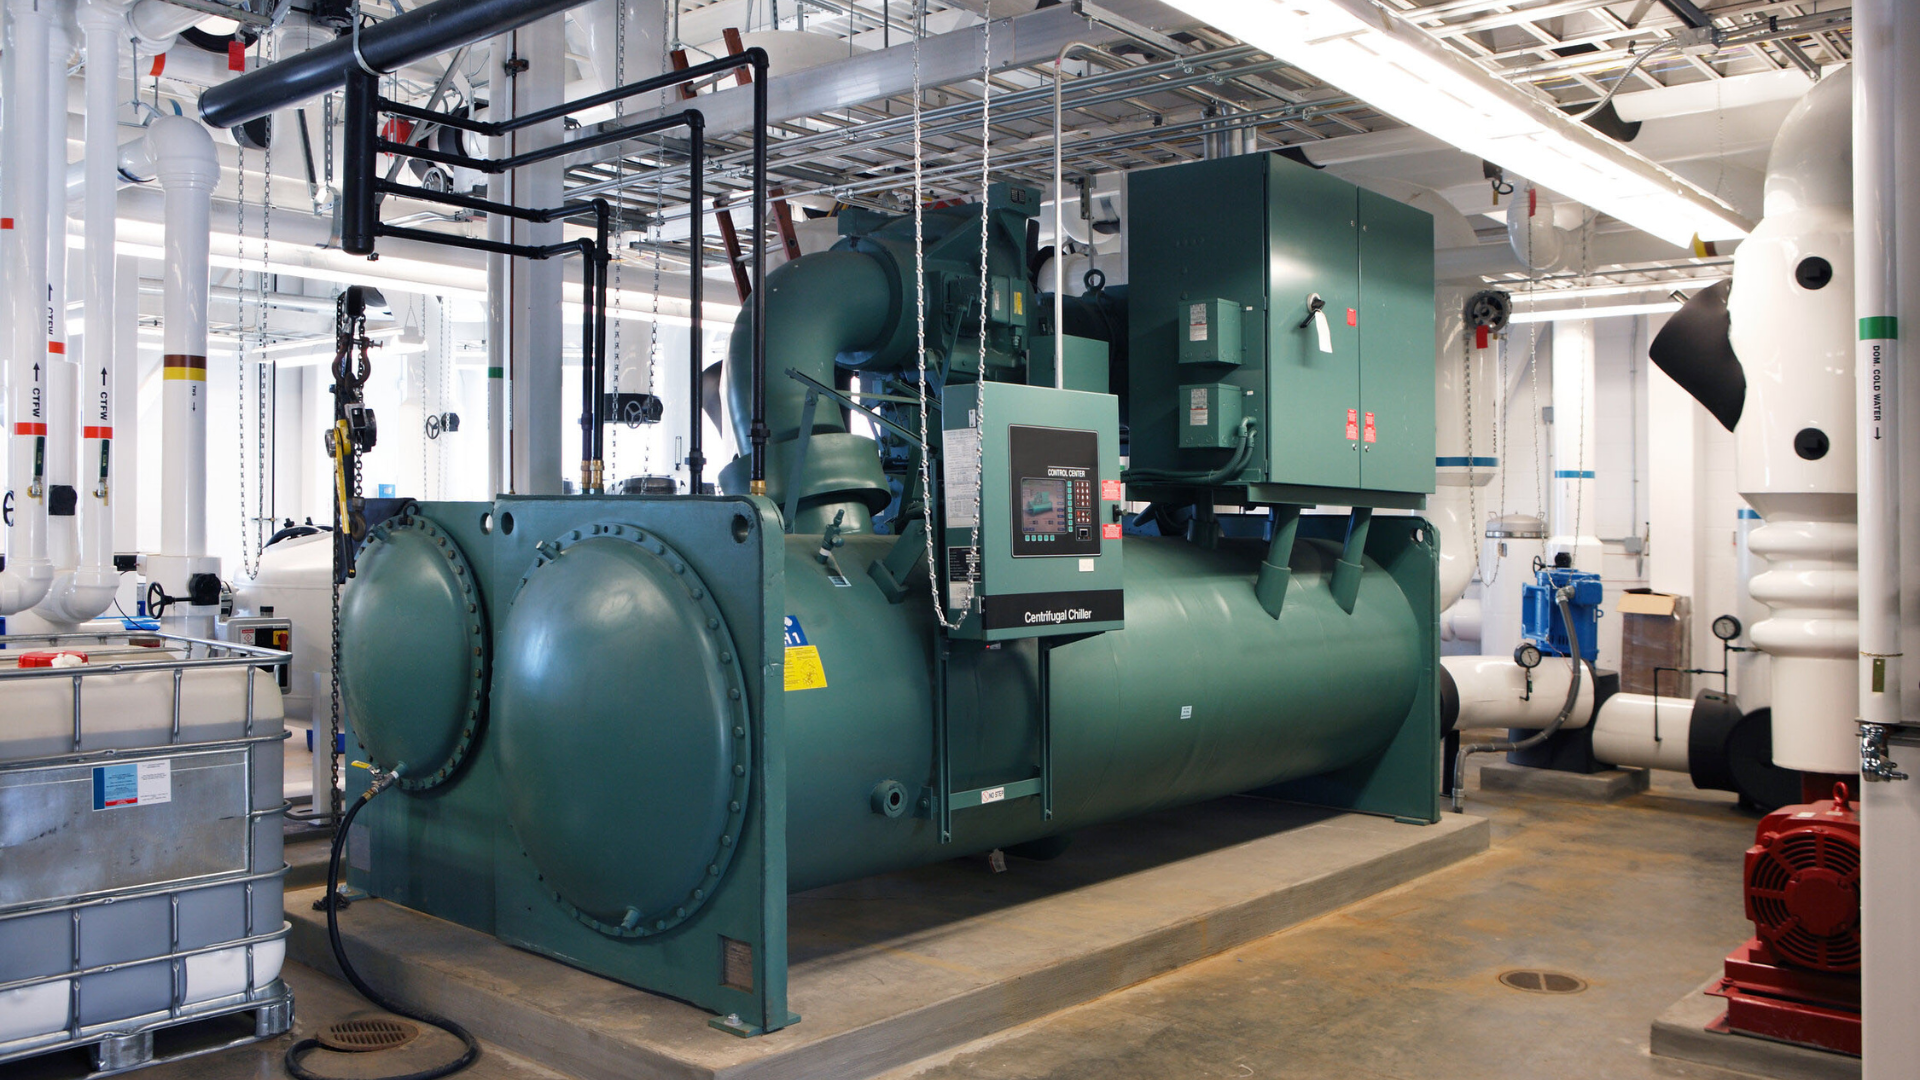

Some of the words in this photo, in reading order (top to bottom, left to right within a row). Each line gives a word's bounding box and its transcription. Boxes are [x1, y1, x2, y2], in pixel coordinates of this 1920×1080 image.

[1873, 369, 1881, 391] COLD
[32, 388, 41, 418] CTFW
[100, 391, 108, 421] CTFW
[1873, 393, 1881, 421] WATER
[1047, 469, 1068, 477] CONTROL
[1024, 609, 1067, 623] Centrifugal
[1068, 608, 1092, 620] Chiller
